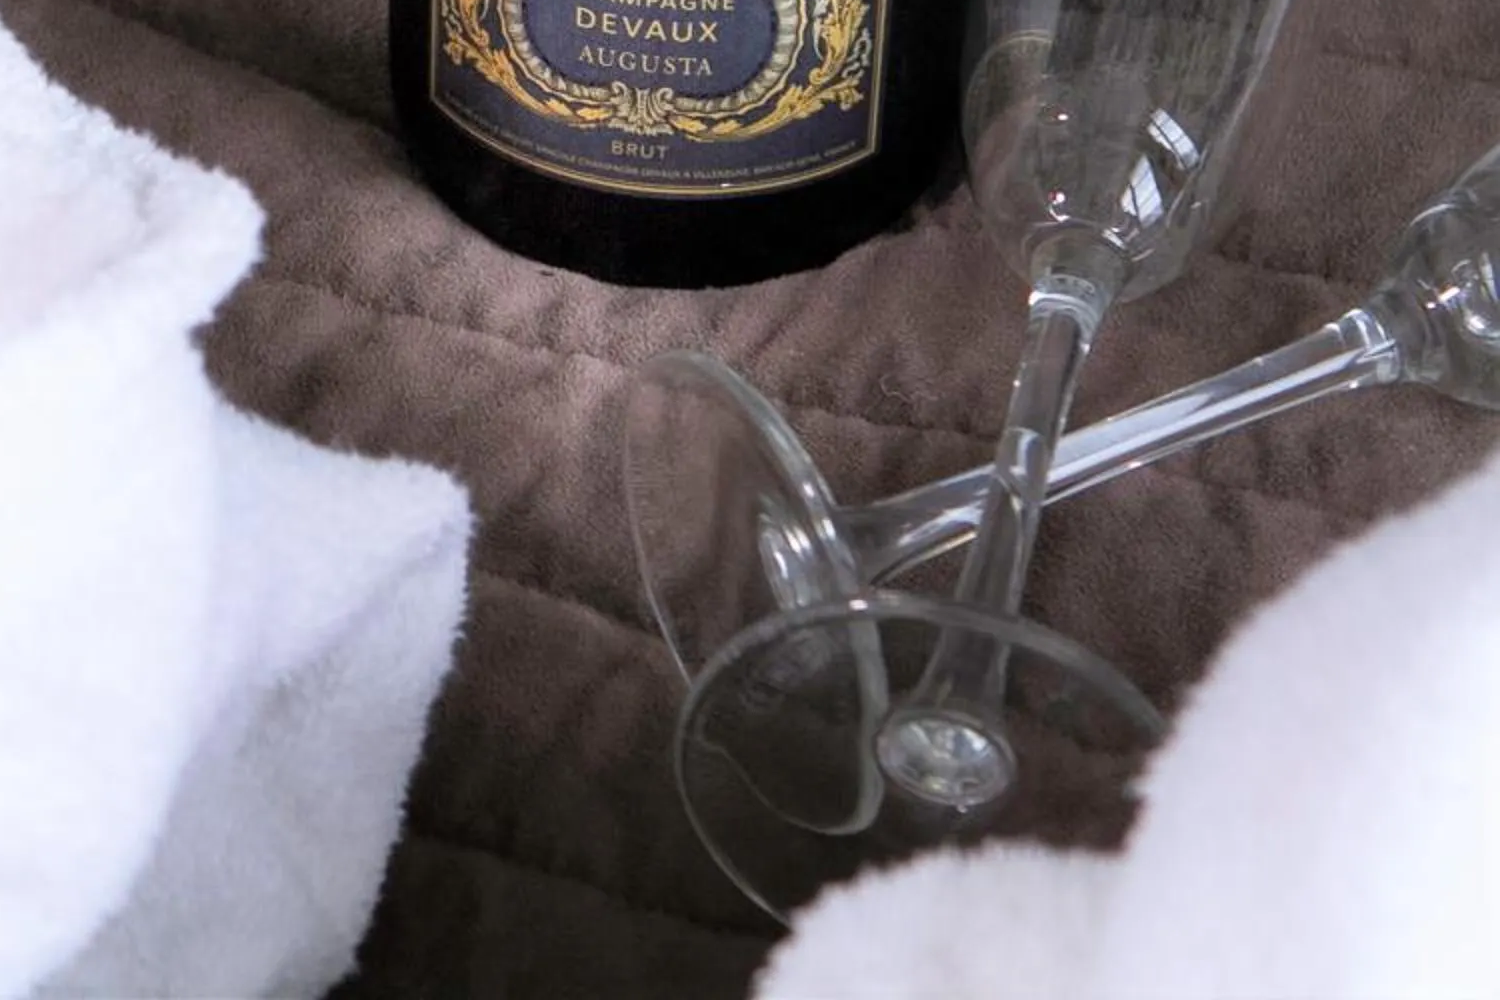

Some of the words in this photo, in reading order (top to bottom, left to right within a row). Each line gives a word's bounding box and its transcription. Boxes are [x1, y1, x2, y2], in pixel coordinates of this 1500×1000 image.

[575, 6, 719, 43] DEVAUX
[579, 45, 714, 77] AUGUSTA
[611, 139, 669, 160] BRUT
